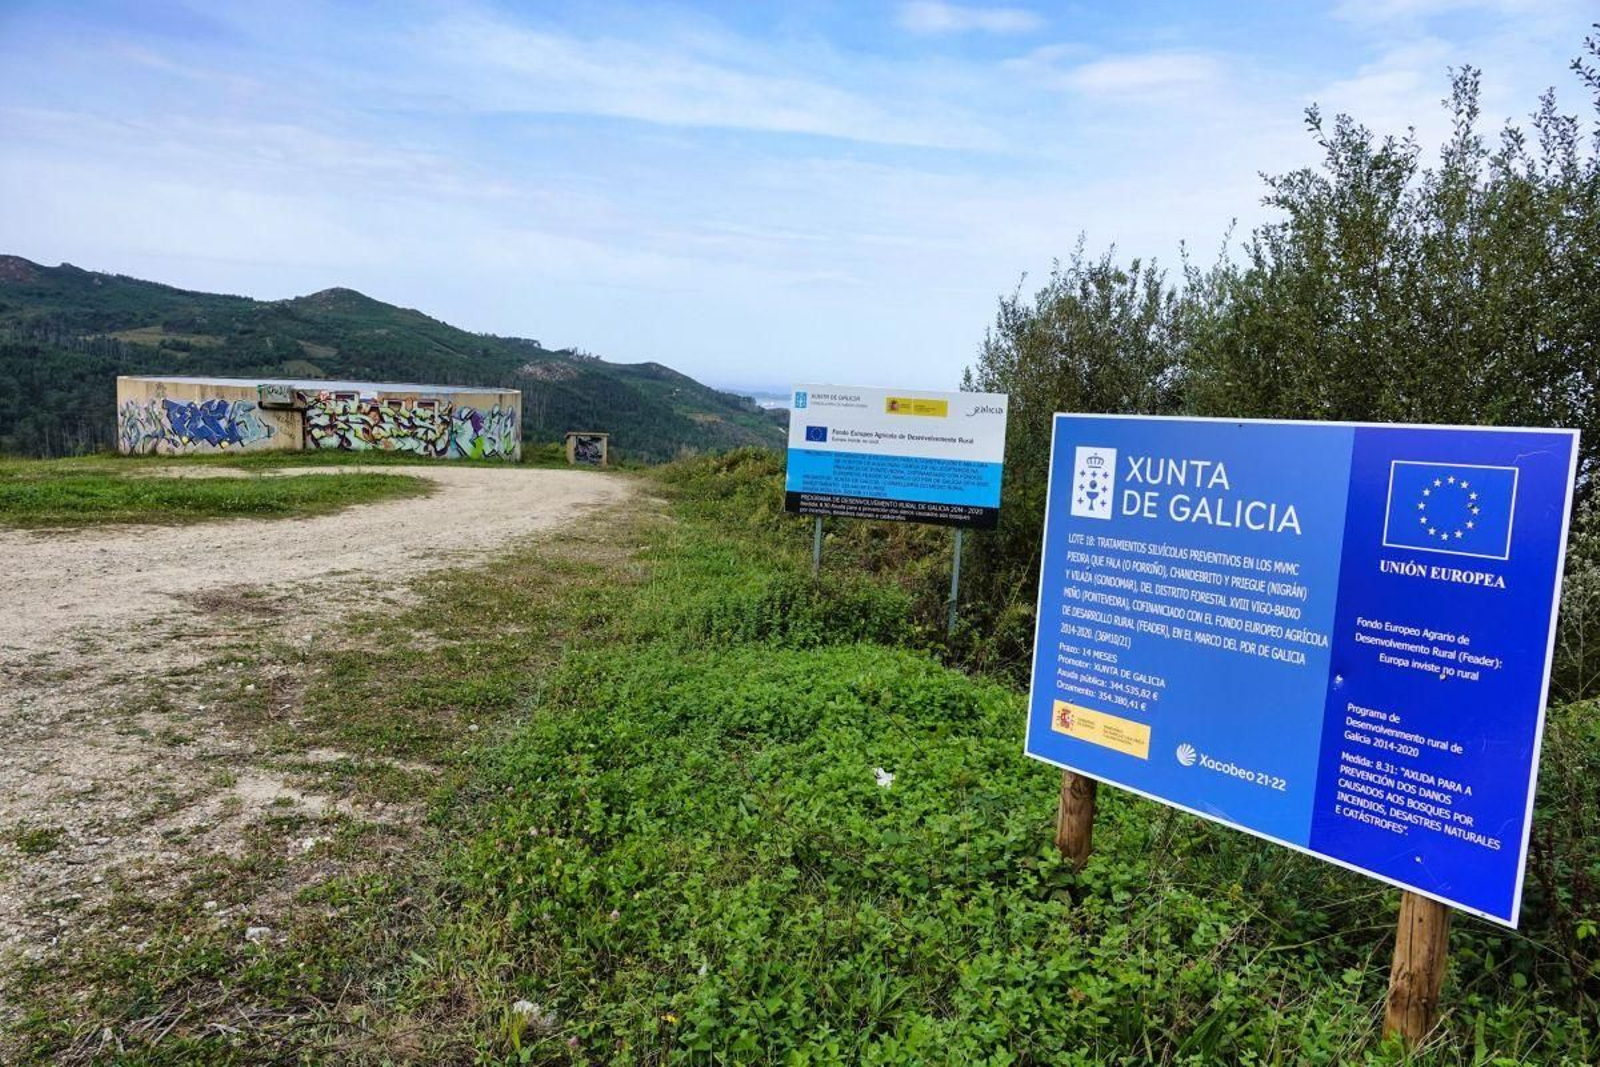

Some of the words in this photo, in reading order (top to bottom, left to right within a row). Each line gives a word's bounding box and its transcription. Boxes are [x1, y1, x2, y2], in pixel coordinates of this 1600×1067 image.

[1126, 456, 1229, 490] XUNTA
[1122, 490, 1159, 518] DE
[1169, 494, 1301, 535] GALICIA
[1068, 533, 1084, 544] LOTE
[1097, 536, 1147, 553] TRATAMIENTOS
[1147, 543, 1188, 559] SILVÍCOLAS
[1189, 549, 1241, 567] PREVENTIVOS
[1243, 556, 1254, 568] EN
[1256, 559, 1272, 571] LOS
[1274, 561, 1299, 575] MVMC
[1067, 551, 1089, 564] PIEDRA
[1090, 554, 1104, 567] QUE
[1106, 557, 1121, 569] FALA
[1170, 566, 1222, 585] CHANDEBRITO
[1224, 575, 1230, 585] Y
[1231, 576, 1265, 592] PRIEGUE
[1267, 582, 1307, 601] (NIGRÁN)
[1380, 560, 1427, 576] UNIÓN
[1430, 566, 1505, 588] EUROPEA
[1066, 569, 1071, 578] Y
[1140, 581, 1153, 594] DEL
[1155, 584, 1189, 600] DISTRITO
[1190, 590, 1227, 607] FORESTAL
[1251, 601, 1301, 619] VIGO-BAIXO
[1063, 585, 1081, 599] MIÑO
[1132, 599, 1185, 619] COFINANCIADO
[1186, 609, 1203, 622] CON
[1204, 613, 1213, 625] EL
[1215, 615, 1243, 630] FONDO
[1244, 620, 1283, 638] EUROPEO
[1284, 627, 1328, 647] AGRÍCOLA
[1356, 617, 1383, 629] Fondo
[1384, 621, 1420, 636] Europeo
[1422, 629, 1455, 642] Agrario
[1457, 634, 1470, 645] de
[1062, 604, 1071, 615] DE
[1071, 606, 1112, 624] DESARROLLO
[1113, 615, 1135, 629] RURAL
[1172, 627, 1183, 638] EN
[1183, 629, 1192, 641] EL
[1194, 631, 1222, 647] MARCO
[1223, 637, 1237, 651] DEL
[1239, 640, 1256, 654] PDR
[1258, 644, 1270, 657] DE
[1271, 647, 1305, 664] GALICIA
[1355, 632, 1430, 654] Desenvolvemento
[1432, 646, 1456, 659] Rural
[1458, 651, 1502, 669] (Feader):
[1059, 642, 1079, 654] Prazo:
[1082, 647, 1091, 656] 14
[1092, 650, 1117, 663] MESES
[1379, 653, 1409, 667] Europa
[1411, 660, 1441, 676] inviste
[1442, 666, 1455, 675] no
[1457, 670, 1479, 680] rural
[1057, 654, 1090, 668] Promotor:
[1094, 663, 1118, 675] XUNTA
[1120, 669, 1130, 679] DE
[1132, 672, 1165, 687] GALICIA
[1057, 667, 1078, 679] Axuda
[1079, 674, 1107, 687] pública:
[1109, 681, 1151, 699] 344.535,82
[1152, 692, 1158, 700] €
[1056, 679, 1096, 697] Orzamento:
[1098, 691, 1138, 709] 354.380,41
[1140, 702, 1146, 711] €
[1347, 703, 1387, 720] Programa
[1388, 713, 1400, 723] de
[1344, 730, 1371, 744] Galicia
[1373, 737, 1419, 757] 2014-2020
[1427, 738, 1448, 750] rural
[1450, 743, 1463, 754] de
[1199, 754, 1255, 781] Xacobeo
[1340, 764, 1395, 788] PREVENCIÓN
[1396, 781, 1416, 794] DOS
[1418, 787, 1451, 804] DANOS
[1341, 751, 1373, 767] Medida:
[1375, 761, 1397, 774] 8.31:
[1437, 778, 1462, 793] PARA
[1464, 786, 1472, 795] A
[1335, 804, 1341, 814] E
[1338, 778, 1384, 799] CAUSADOS
[1386, 792, 1405, 806] AOS
[1407, 798, 1451, 819] BOSQUES
[1453, 812, 1473, 826] POR
[1337, 791, 1386, 815] INCENDIOS,
[1389, 807, 1441, 831] DESASTRES
[1444, 824, 1500, 850] NATURALES
